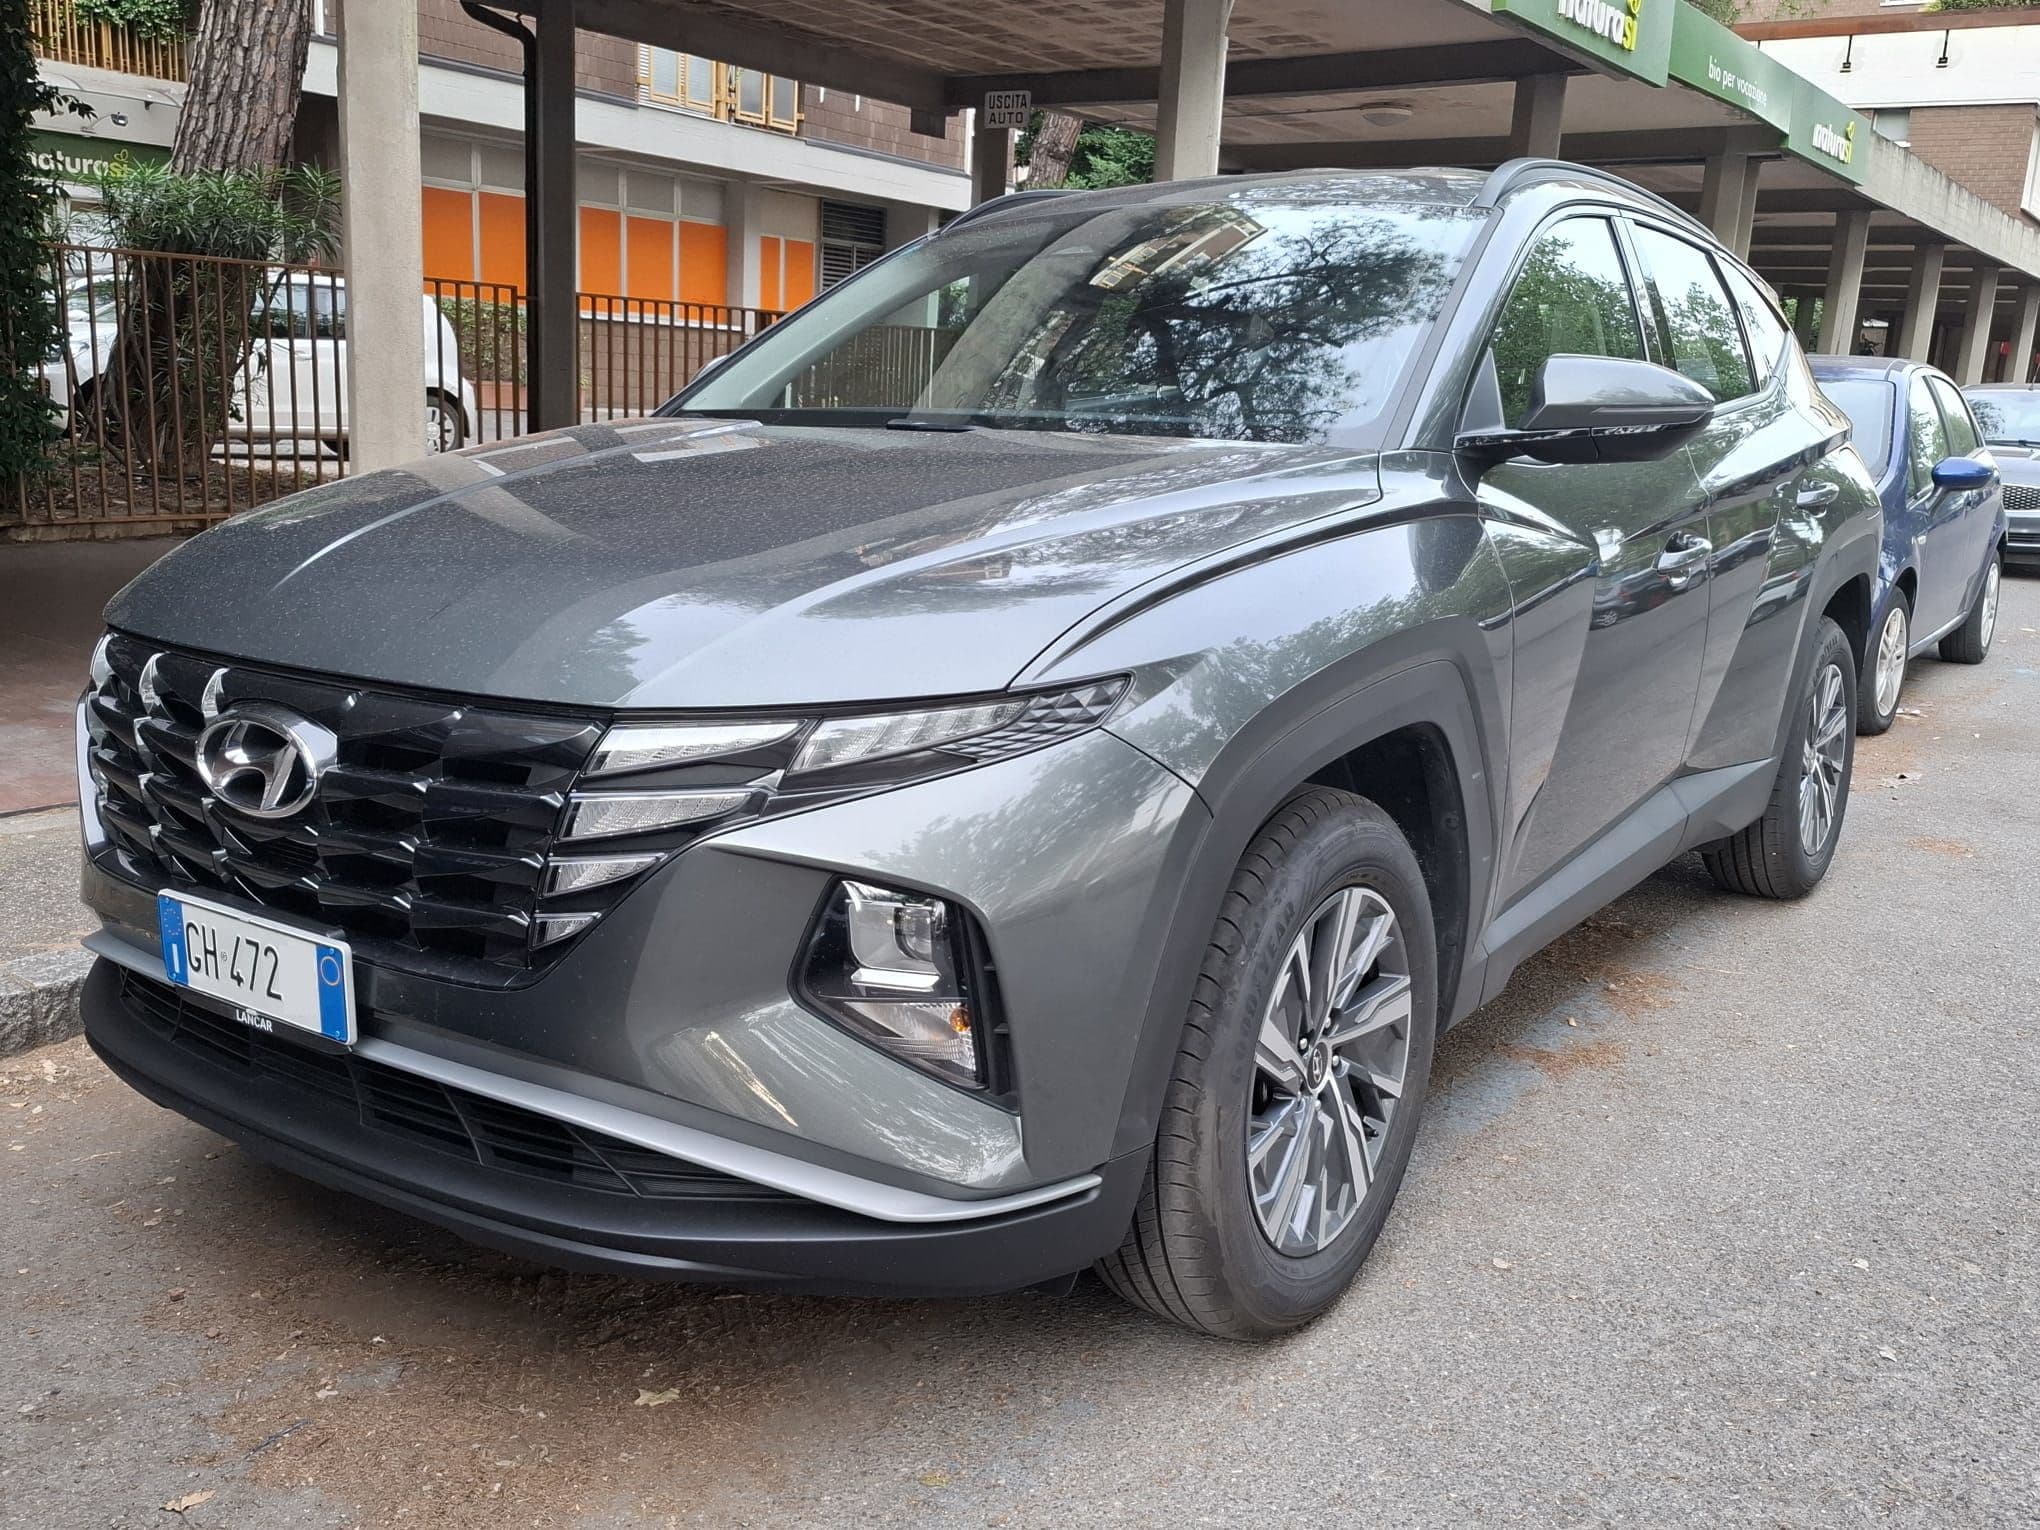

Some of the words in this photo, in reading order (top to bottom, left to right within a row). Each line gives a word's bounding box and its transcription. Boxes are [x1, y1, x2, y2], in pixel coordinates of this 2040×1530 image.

[1708, 55, 1721, 82] bio
[1722, 70, 1736, 90] per
[1737, 77, 1768, 106] vocazione
[989, 94, 1027, 109] USCITA
[989, 111, 1024, 125] AUTO
[186, 921, 219, 980] GH
[230, 936, 283, 1001] 472
[235, 1008, 273, 1032] LANCAR
